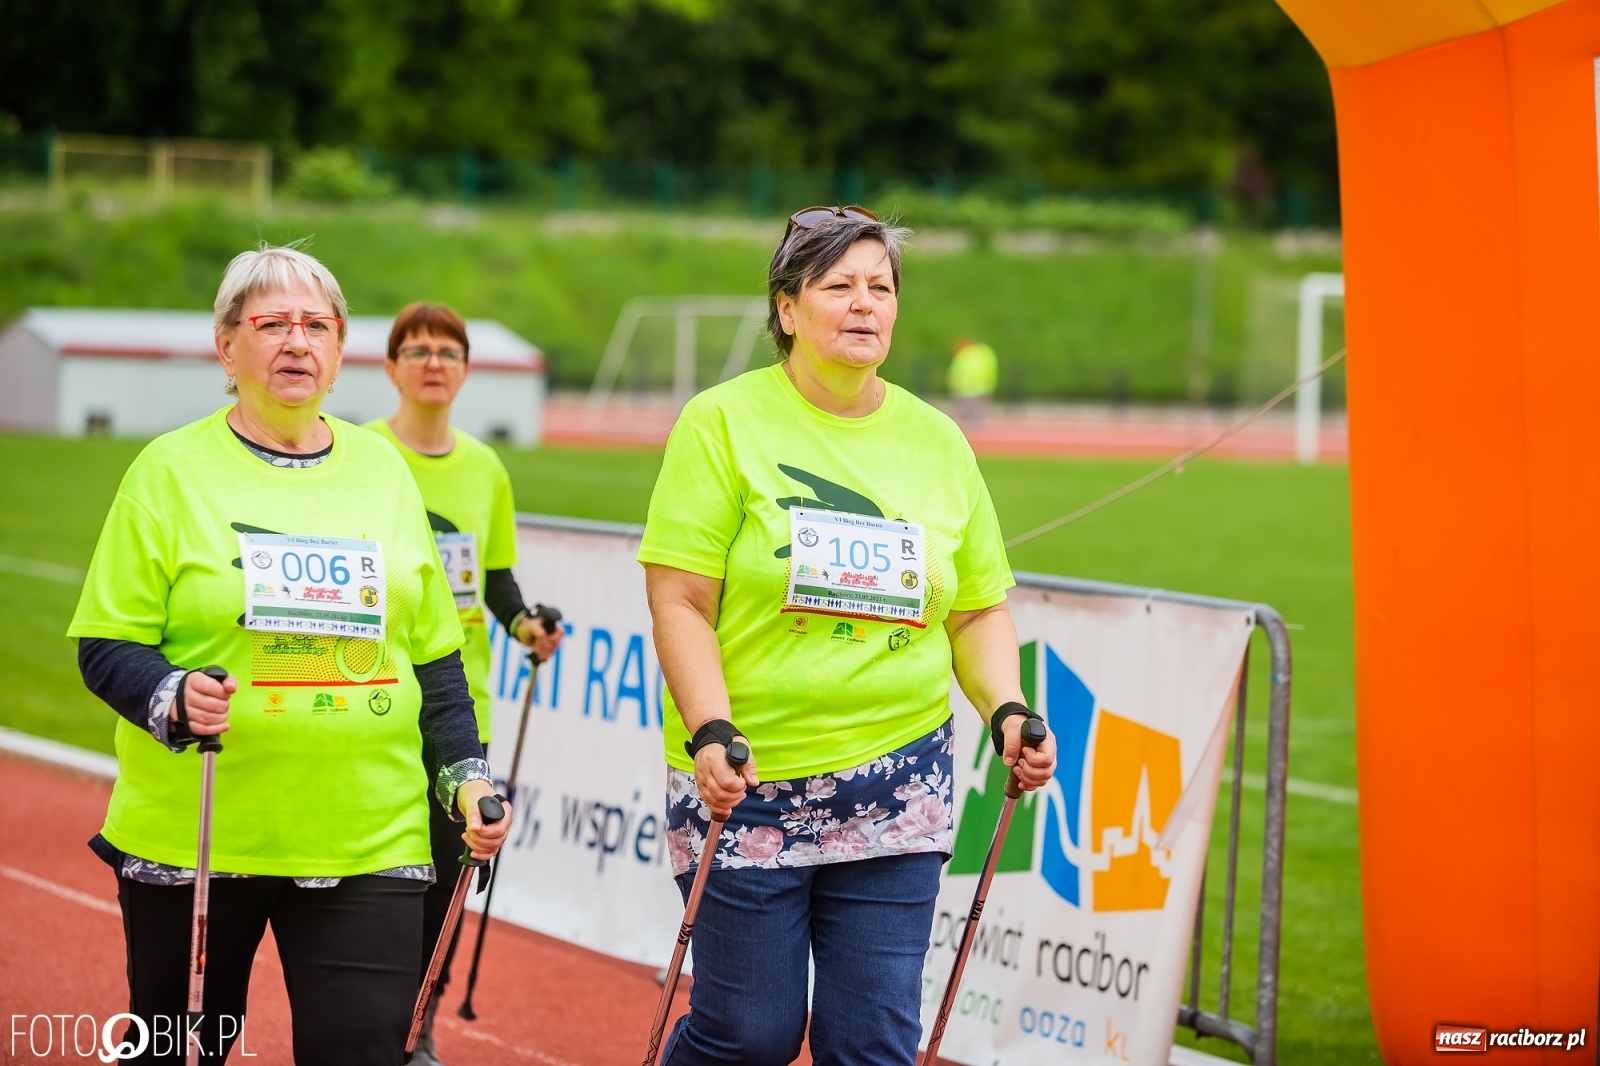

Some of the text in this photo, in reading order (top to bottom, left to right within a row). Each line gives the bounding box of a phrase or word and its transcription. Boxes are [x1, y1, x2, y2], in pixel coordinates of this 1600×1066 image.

[843, 518, 855, 526] Bieg
[866, 521, 883, 529] Barier
[281, 551, 351, 586] 006
[828, 537, 891, 573] 105
[490, 617, 573, 709] IAT
[1019, 1005, 1087, 1049] oaza
